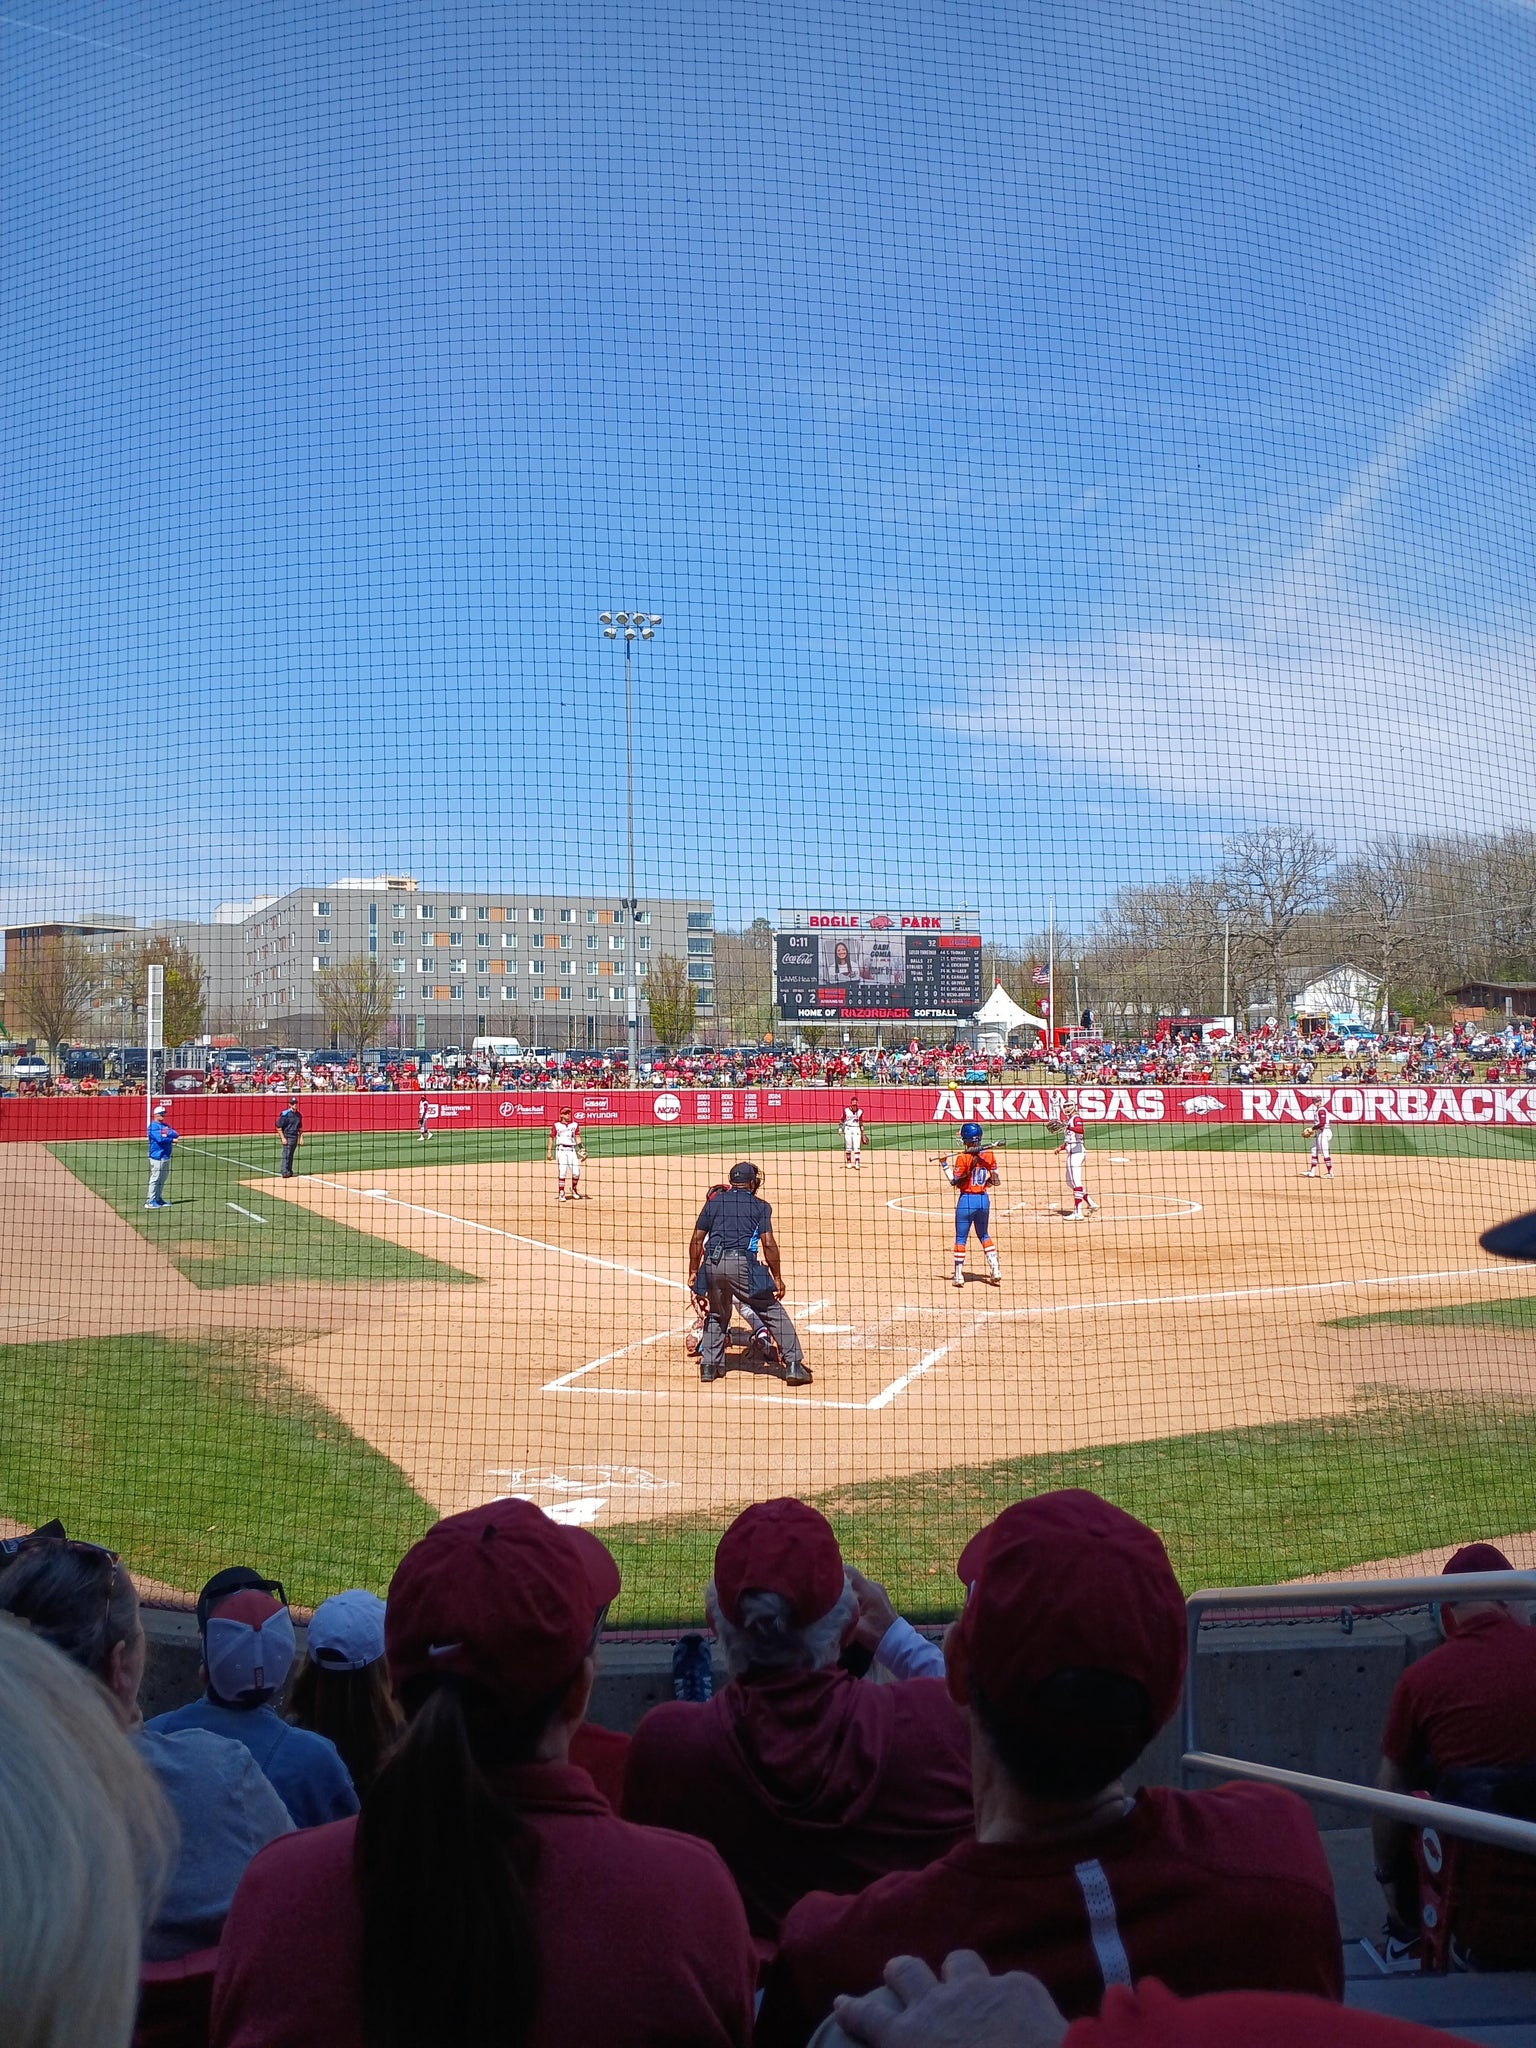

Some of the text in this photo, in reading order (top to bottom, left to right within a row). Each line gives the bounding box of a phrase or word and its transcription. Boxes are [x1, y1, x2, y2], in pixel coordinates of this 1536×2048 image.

[809, 916, 941, 928] BOGLE PARK
[789, 937, 808, 947] 0:11
[782, 994, 816, 1003] 1 0 2
[798, 1008, 957, 1018] HOME OF RAZORBACK SOFTBALL
[933, 1089, 1165, 1120] ARKANSAS
[972, 1167, 987, 1186] 10
